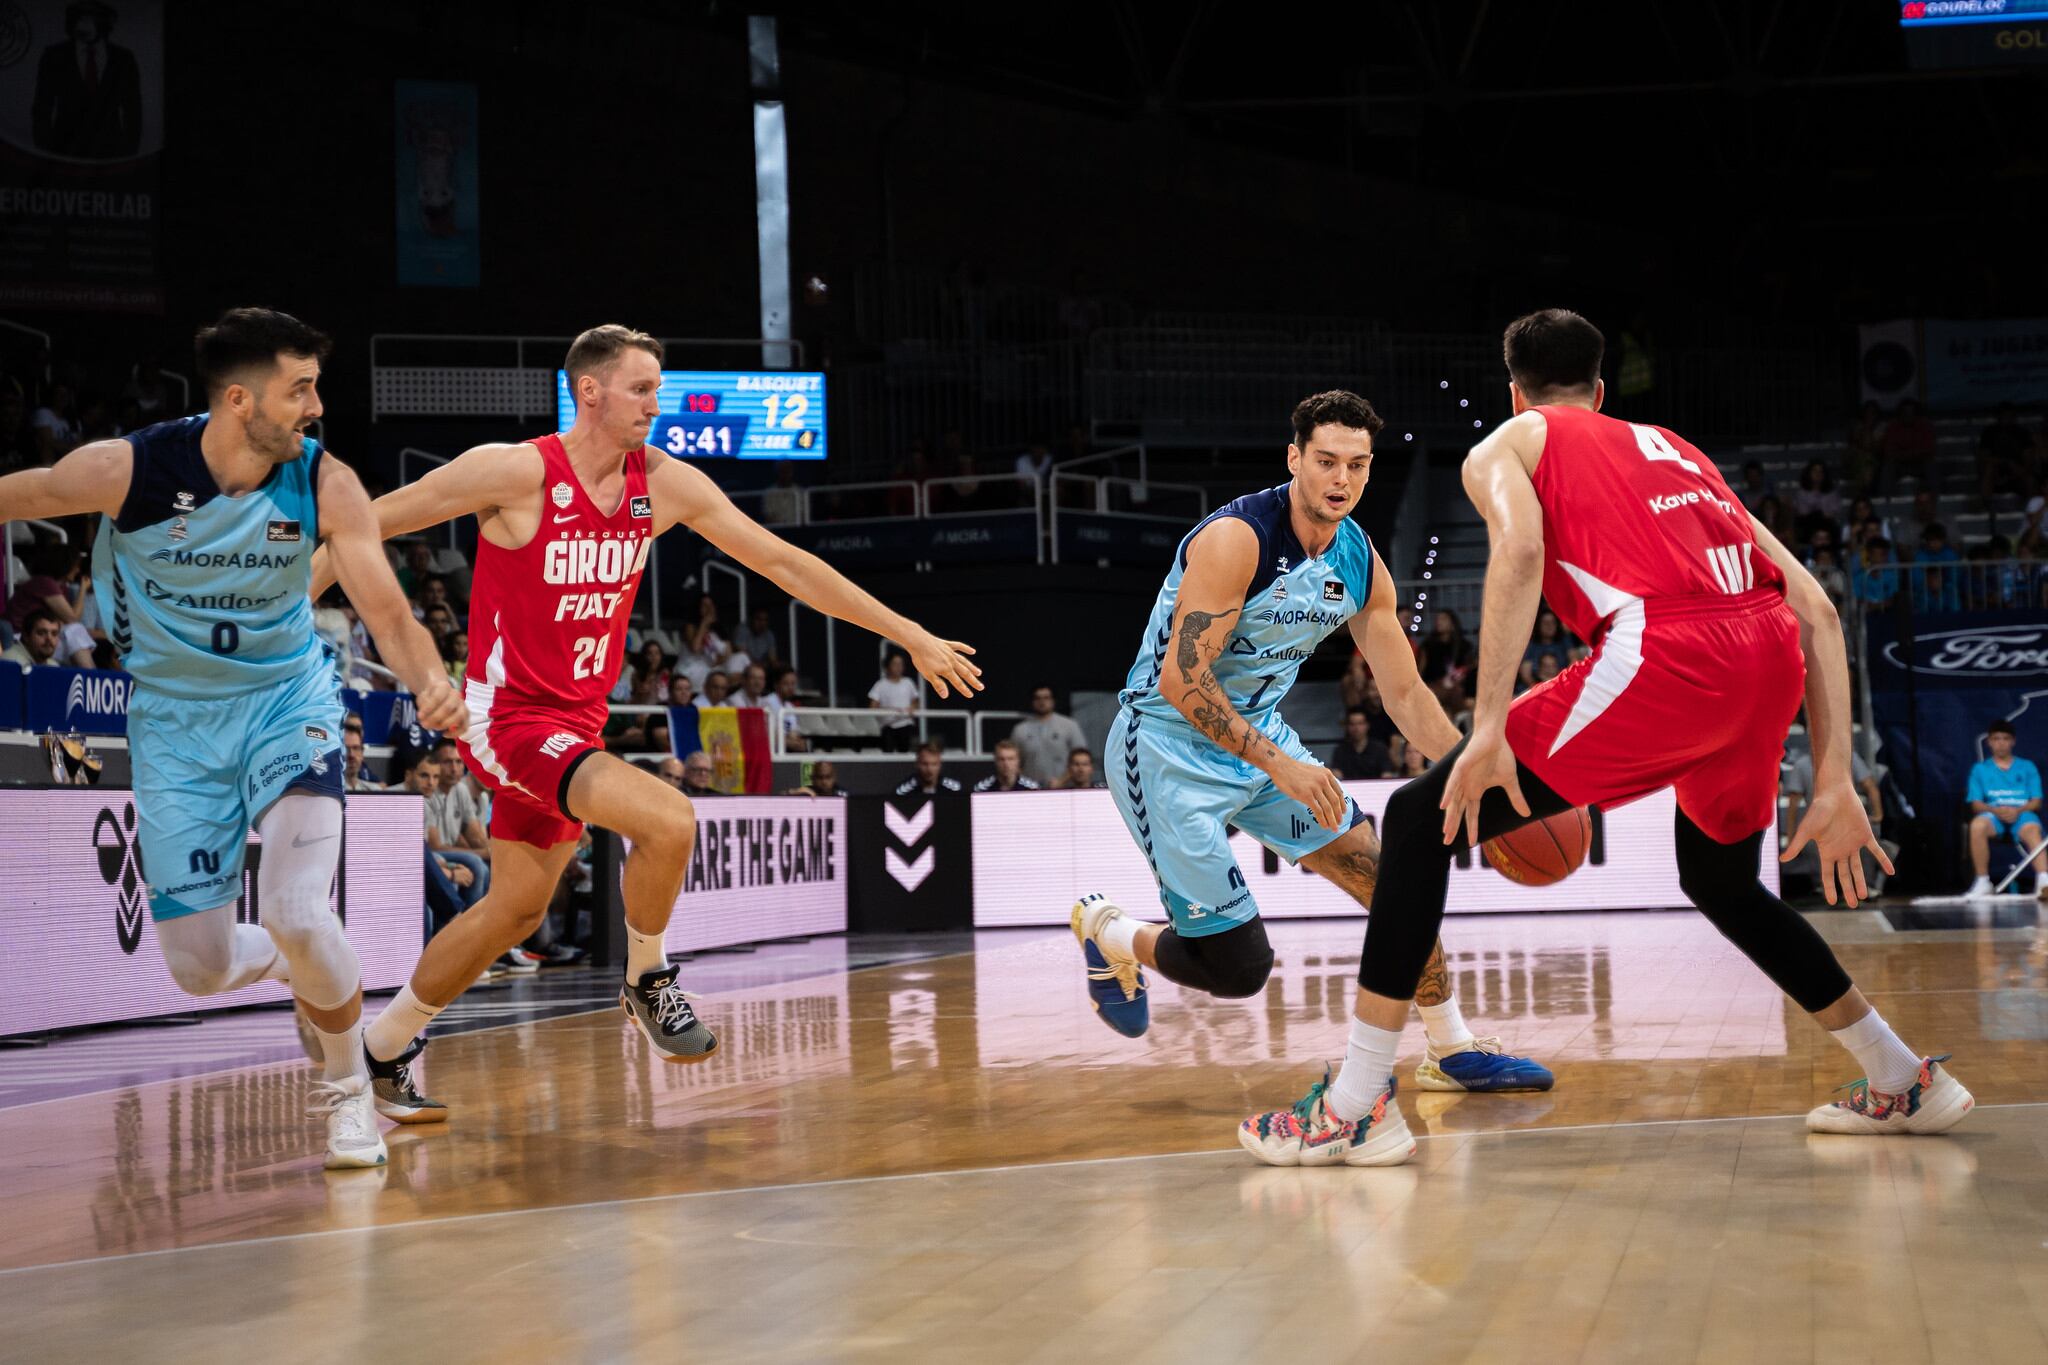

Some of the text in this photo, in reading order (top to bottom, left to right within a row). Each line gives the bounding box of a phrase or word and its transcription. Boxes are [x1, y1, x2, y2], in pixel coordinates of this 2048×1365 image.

[762, 393, 809, 429] 12
[666, 426, 732, 454] 3:41
[799, 430, 813, 448] 4
[1629, 423, 1701, 474] 4
[1649, 491, 1699, 514] Kave
[211, 621, 239, 654] 0
[573, 633, 610, 681] 29
[736, 818, 774, 887] THE
[779, 817, 835, 884] GAME
